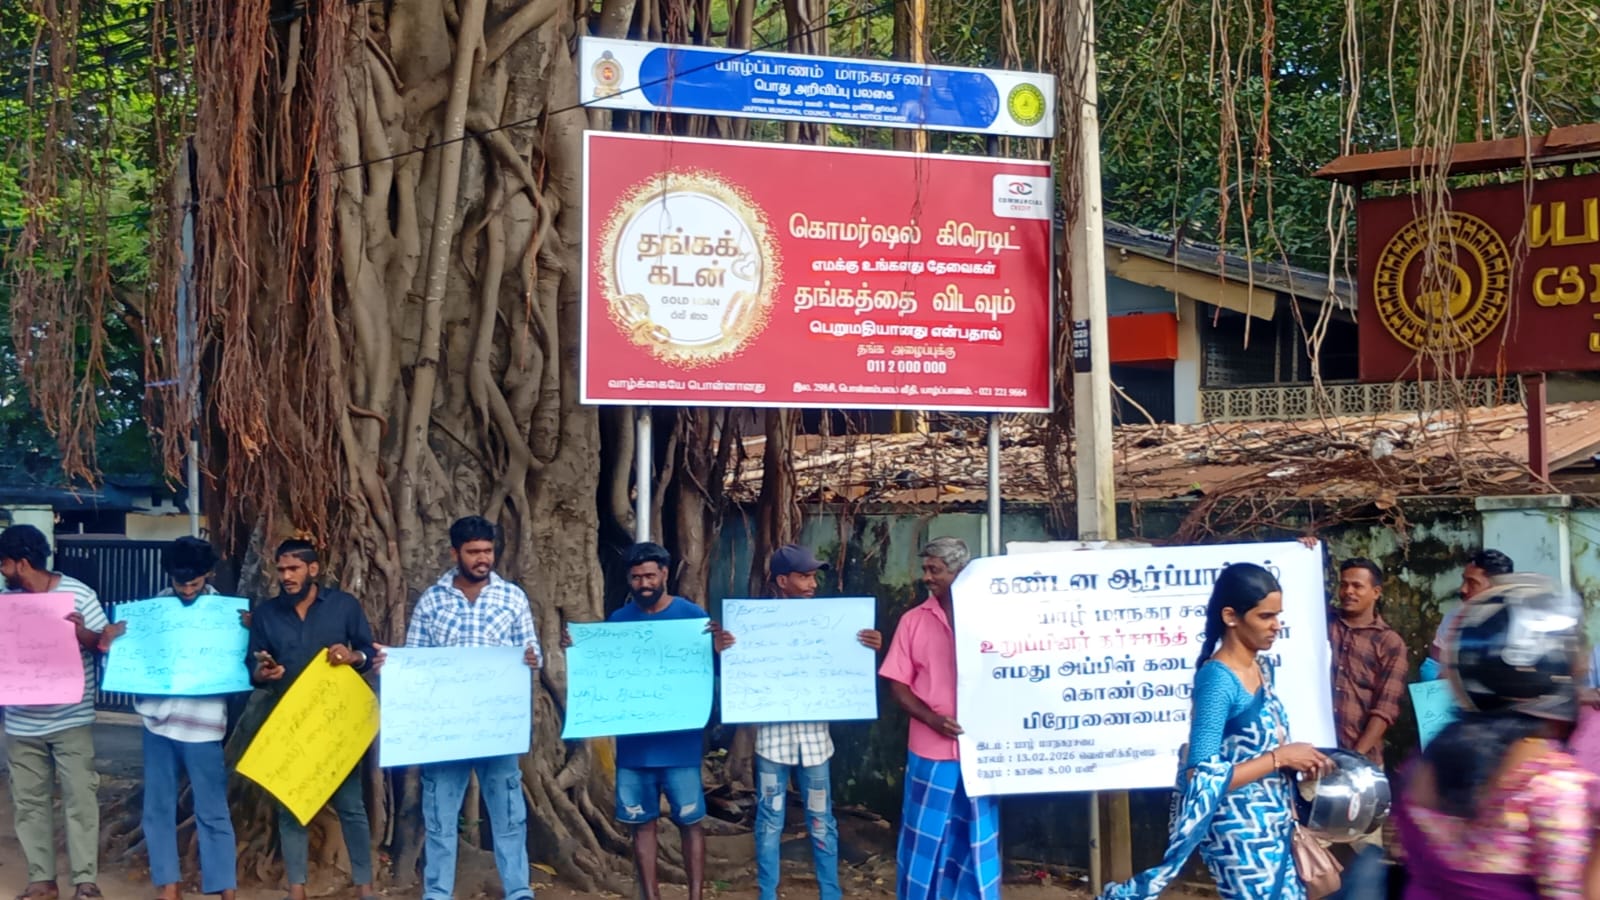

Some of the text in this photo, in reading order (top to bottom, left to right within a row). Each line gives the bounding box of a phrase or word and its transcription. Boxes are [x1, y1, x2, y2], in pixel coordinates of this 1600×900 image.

[715, 59, 932, 87] யாழ்ப்பாணம் மாநகரசபை
[754, 79, 895, 100] பொது அறிவிப்பு பலகை
[637, 227, 738, 262] தங்கக்
[789, 212, 1021, 255] கொமர்ஷல் கிரெடிட்
[648, 260, 726, 287] கடன்
[812, 257, 859, 274] எமக்கு
[927, 260, 996, 276] தேவைகள்
[661, 296, 689, 305] GOLD
[794, 280, 1016, 321] தங்கத்தை விடவும்
[809, 320, 1002, 342] பெறுமதியானது என்பதால்
[857, 342, 885, 356] தங்க
[867, 360, 946, 374] 011 2 000 000
[989, 570, 1099, 596] கண்டன
[1038, 603, 1088, 627] யாழ்
[1095, 603, 1172, 624] மாநகர
[992, 664, 1050, 683] எமது
[1058, 654, 1135, 676] அப்பிள்
[1016, 750, 1075, 763] 13.02.2026
[1048, 764, 1072, 776] 8.00
